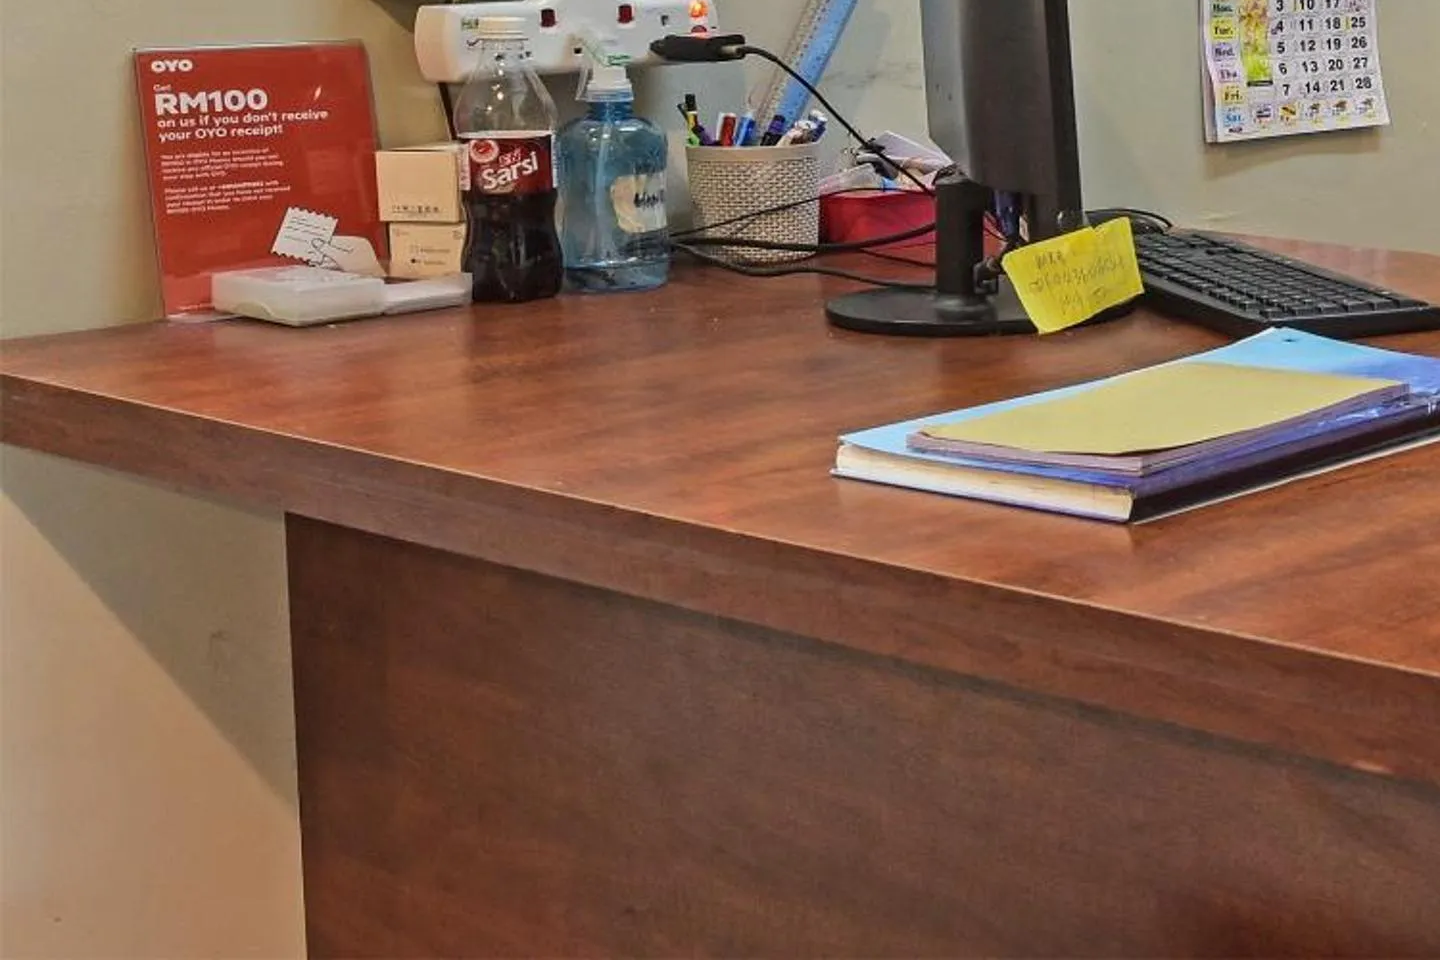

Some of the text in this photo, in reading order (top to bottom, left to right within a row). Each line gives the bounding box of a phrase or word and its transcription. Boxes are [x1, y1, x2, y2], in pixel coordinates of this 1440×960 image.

[1276, 0, 1284, 12] 3
[1276, 21, 1284, 33] 4
[1300, 19, 1313, 31] 11
[1326, 17, 1341, 29] 18
[1351, 17, 1366, 28] 25
[1277, 42, 1285, 54] 5
[1300, 40, 1316, 52] 12
[1326, 38, 1341, 50] 19
[1351, 36, 1367, 48] 26
[151, 59, 194, 74] OYO
[1279, 63, 1287, 75] 6
[1302, 61, 1318, 73] 13
[1328, 59, 1344, 71] 20
[1353, 57, 1368, 69] 27
[1305, 81, 1320, 93] 14
[1330, 80, 1344, 92] 21
[1355, 77, 1372, 89] 28
[1282, 84, 1290, 96] 7
[154, 88, 268, 116] RM100
[157, 109, 328, 128] on us if you don't receive
[159, 131, 191, 144] your
[195, 128, 227, 140] OYO
[481, 150, 539, 190] Sarsi
